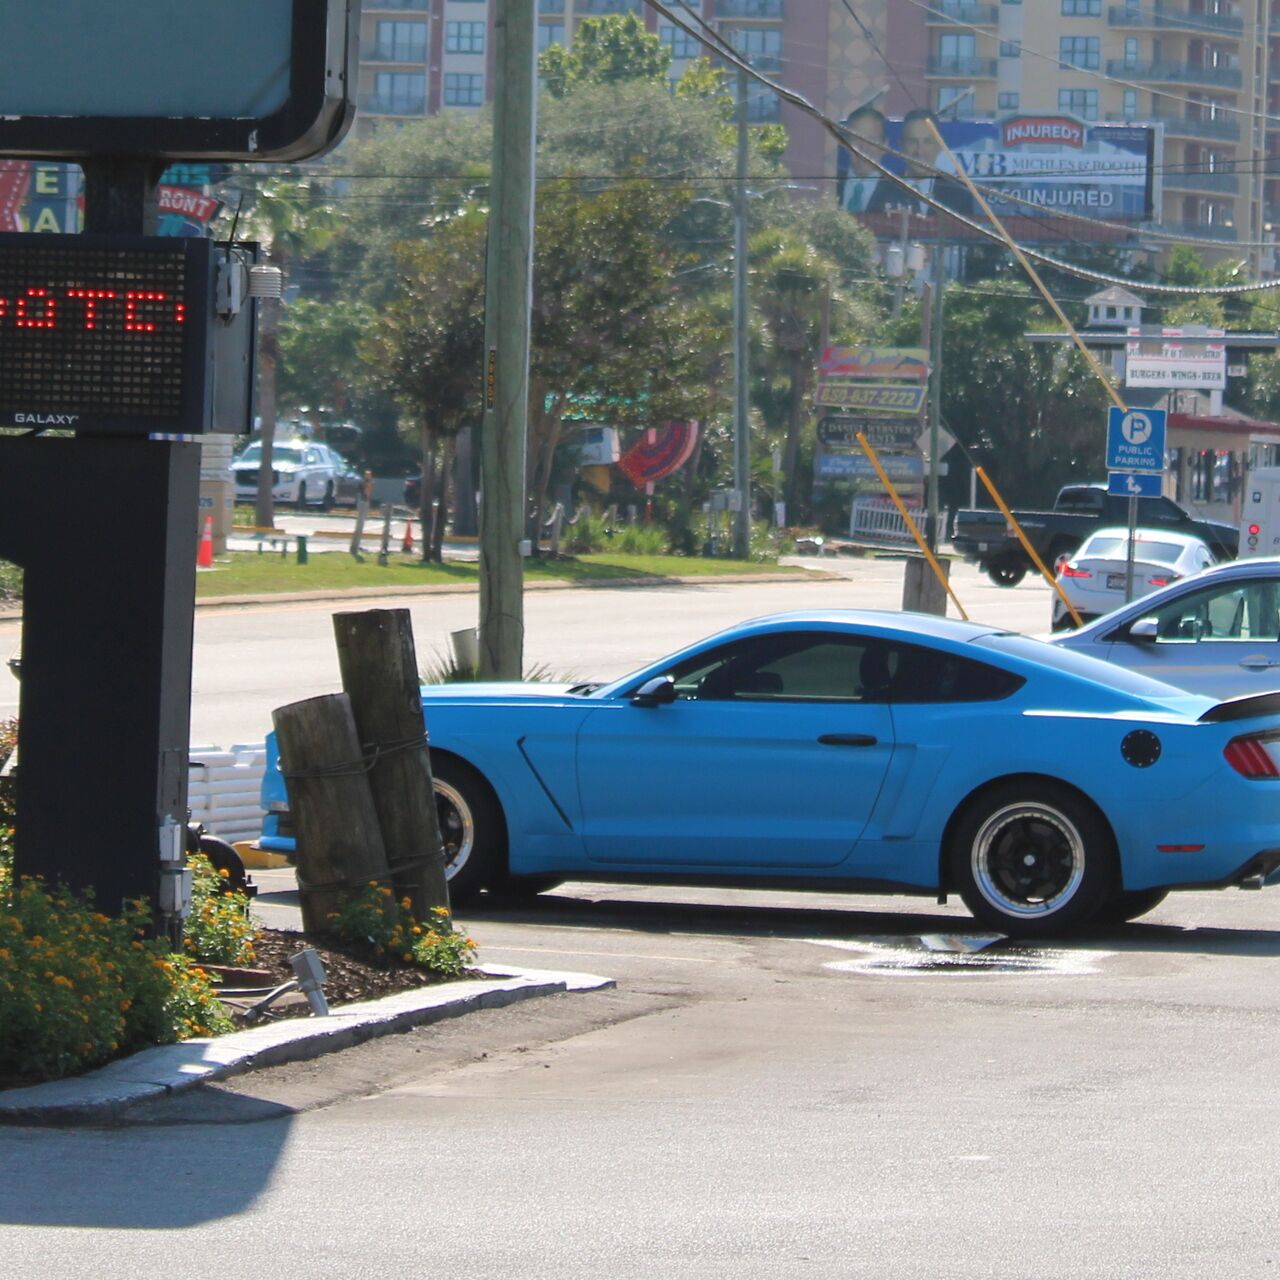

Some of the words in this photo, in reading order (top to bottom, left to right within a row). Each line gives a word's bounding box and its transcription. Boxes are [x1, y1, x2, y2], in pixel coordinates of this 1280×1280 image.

[1006, 124, 1080, 143] INJURED?
[1026, 189, 1113, 207] INJURED
[1118, 444, 1153, 456] PUBLIC
[1114, 455, 1156, 467] PARKING
